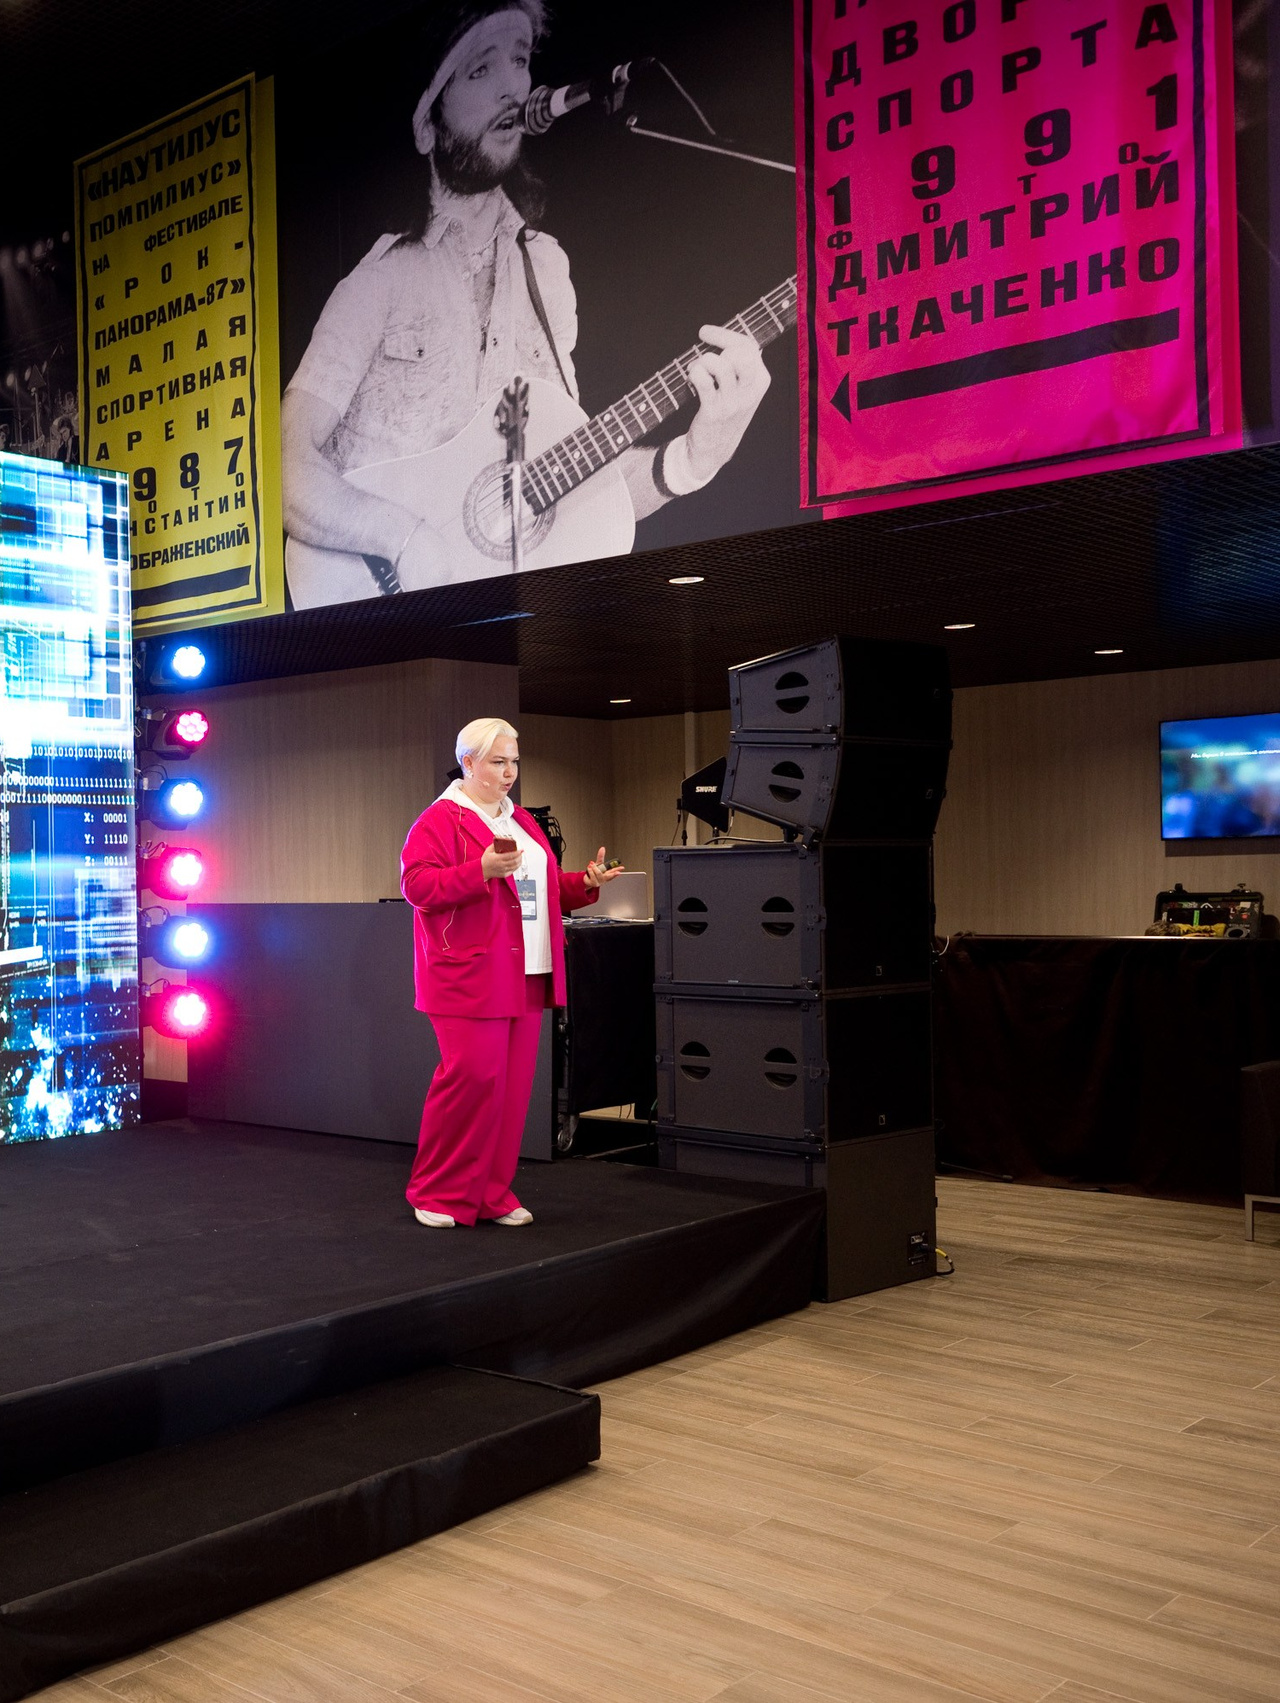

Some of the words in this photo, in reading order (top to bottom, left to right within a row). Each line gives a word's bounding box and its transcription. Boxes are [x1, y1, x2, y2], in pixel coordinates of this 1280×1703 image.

[825, 3, 1179, 152] СПОРТА
[87, 108, 241, 201] «НАУТИЛУС
[826, 73, 1179, 226] 1991
[90, 158, 242, 242] ПОМПИЛИУС»
[93, 254, 110, 276] НА
[143, 194, 243, 253] ФЕСТИВАЛЕ
[828, 149, 1180, 302] ДМИТРИЙ
[95, 277, 246, 350] ПАНОРАМА-87»
[827, 237, 1180, 357] ТКАЧЕНКО
[96, 314, 246, 388] МАЛАЯ
[96, 355, 247, 425] СПОРТИВНАЯ
[95, 397, 246, 462] АРЕНА
[133, 436, 244, 502] 987
[148, 471, 245, 513] ОТО
[129, 489, 246, 537] НСТАНТИН
[130, 522, 250, 571] ОБРАЖЕНСКИЙ
[103, 813, 128, 824] 00001
[104, 834, 128, 844] 11110
[104, 856, 128, 866] 00111
